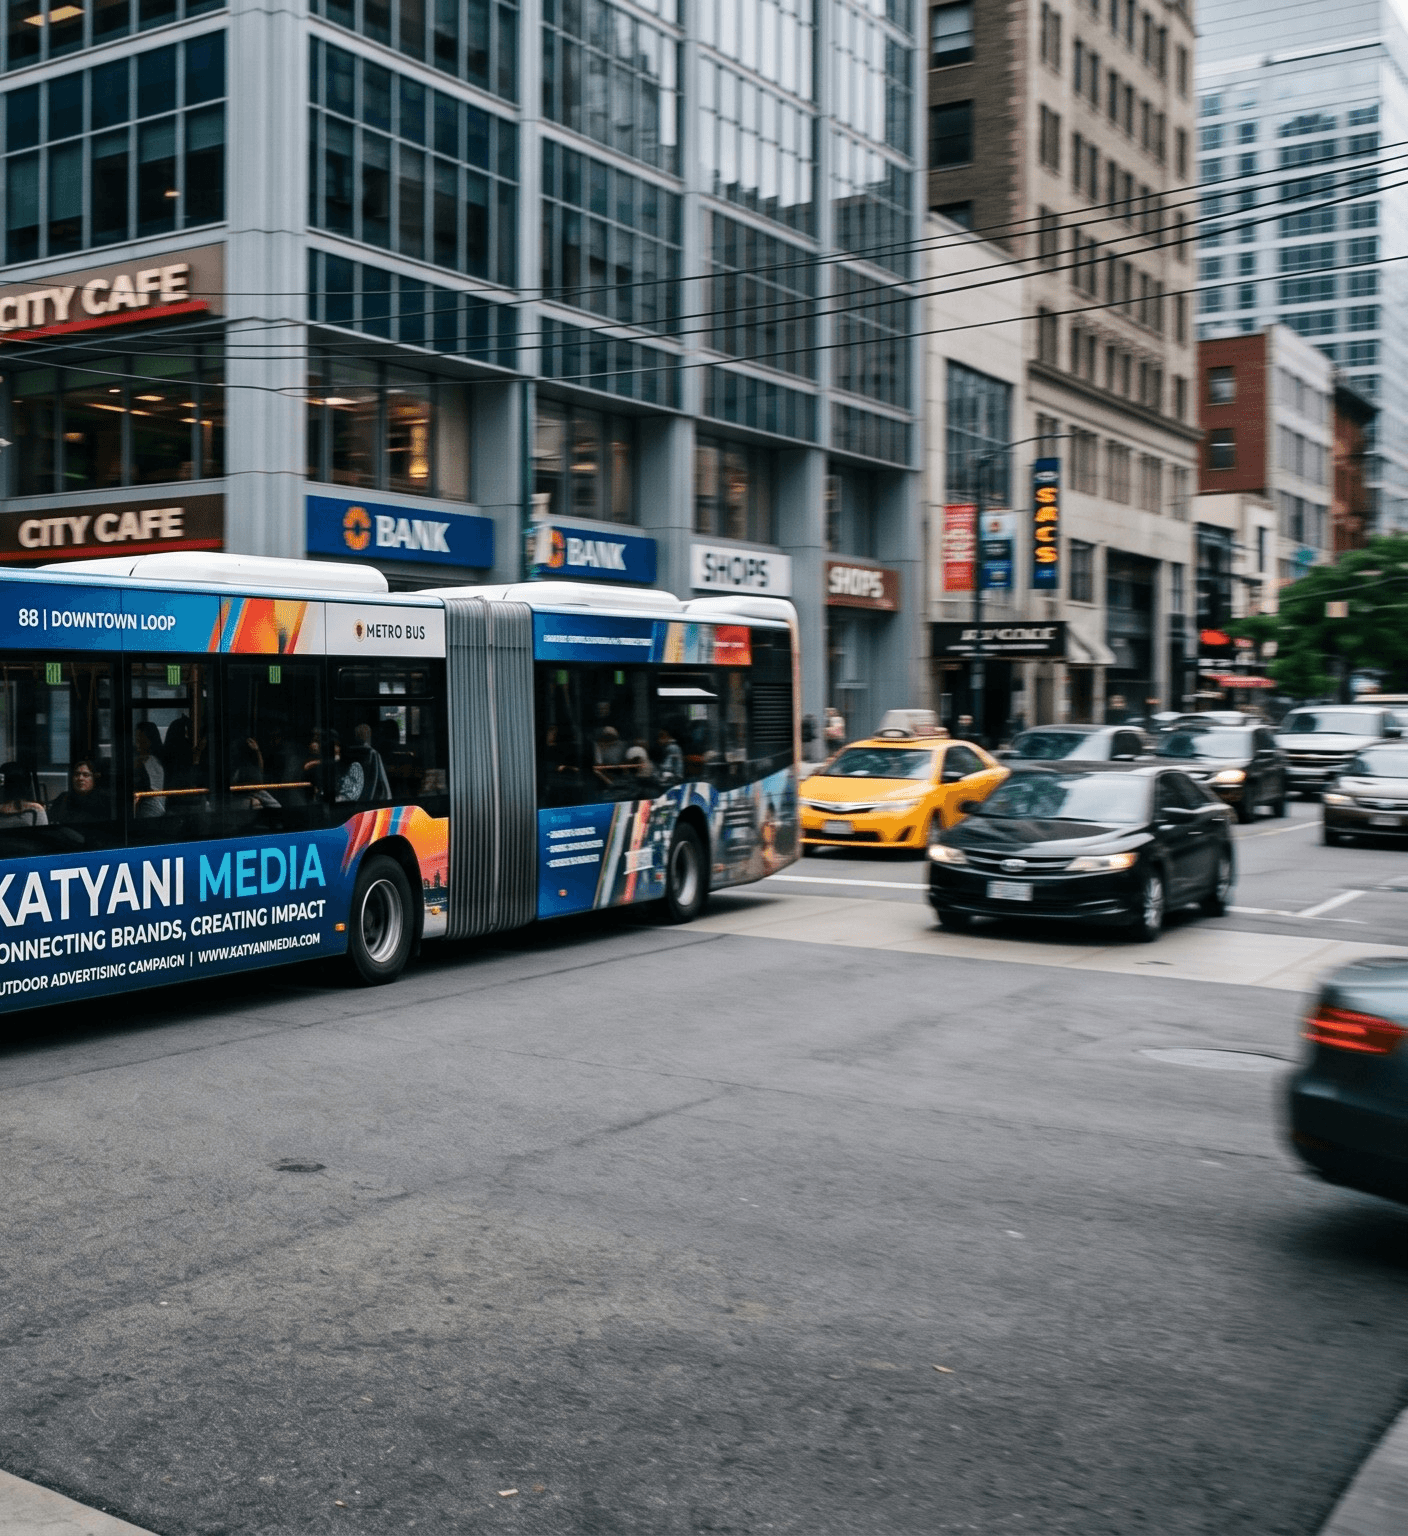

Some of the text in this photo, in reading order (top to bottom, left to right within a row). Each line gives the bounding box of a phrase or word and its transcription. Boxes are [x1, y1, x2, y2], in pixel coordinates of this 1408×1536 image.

[81, 262, 190, 314] CAFE
[17, 507, 185, 548] CITY CAFE
[375, 515, 451, 553] BANK
[566, 538, 626, 570] BANK
[701, 550, 771, 587] SHOPS
[828, 566, 884, 598] SHOPS
[18, 608, 39, 627] 88
[51, 610, 137, 630] DOWNTOWN
[140, 614, 176, 631] LOOP
[366, 623, 426, 640] METRO BUS
[199, 843, 326, 902] MEDIA
[111, 919, 187, 948] BRANDS,
[190, 906, 267, 937] CREATING
[271, 899, 326, 924] IMPACT
[51, 962, 126, 987] ADVERTISING
[129, 954, 185, 975] CAMPAIGN
[198, 932, 321, 963] WWW.KATYANIMEDIA.COM
